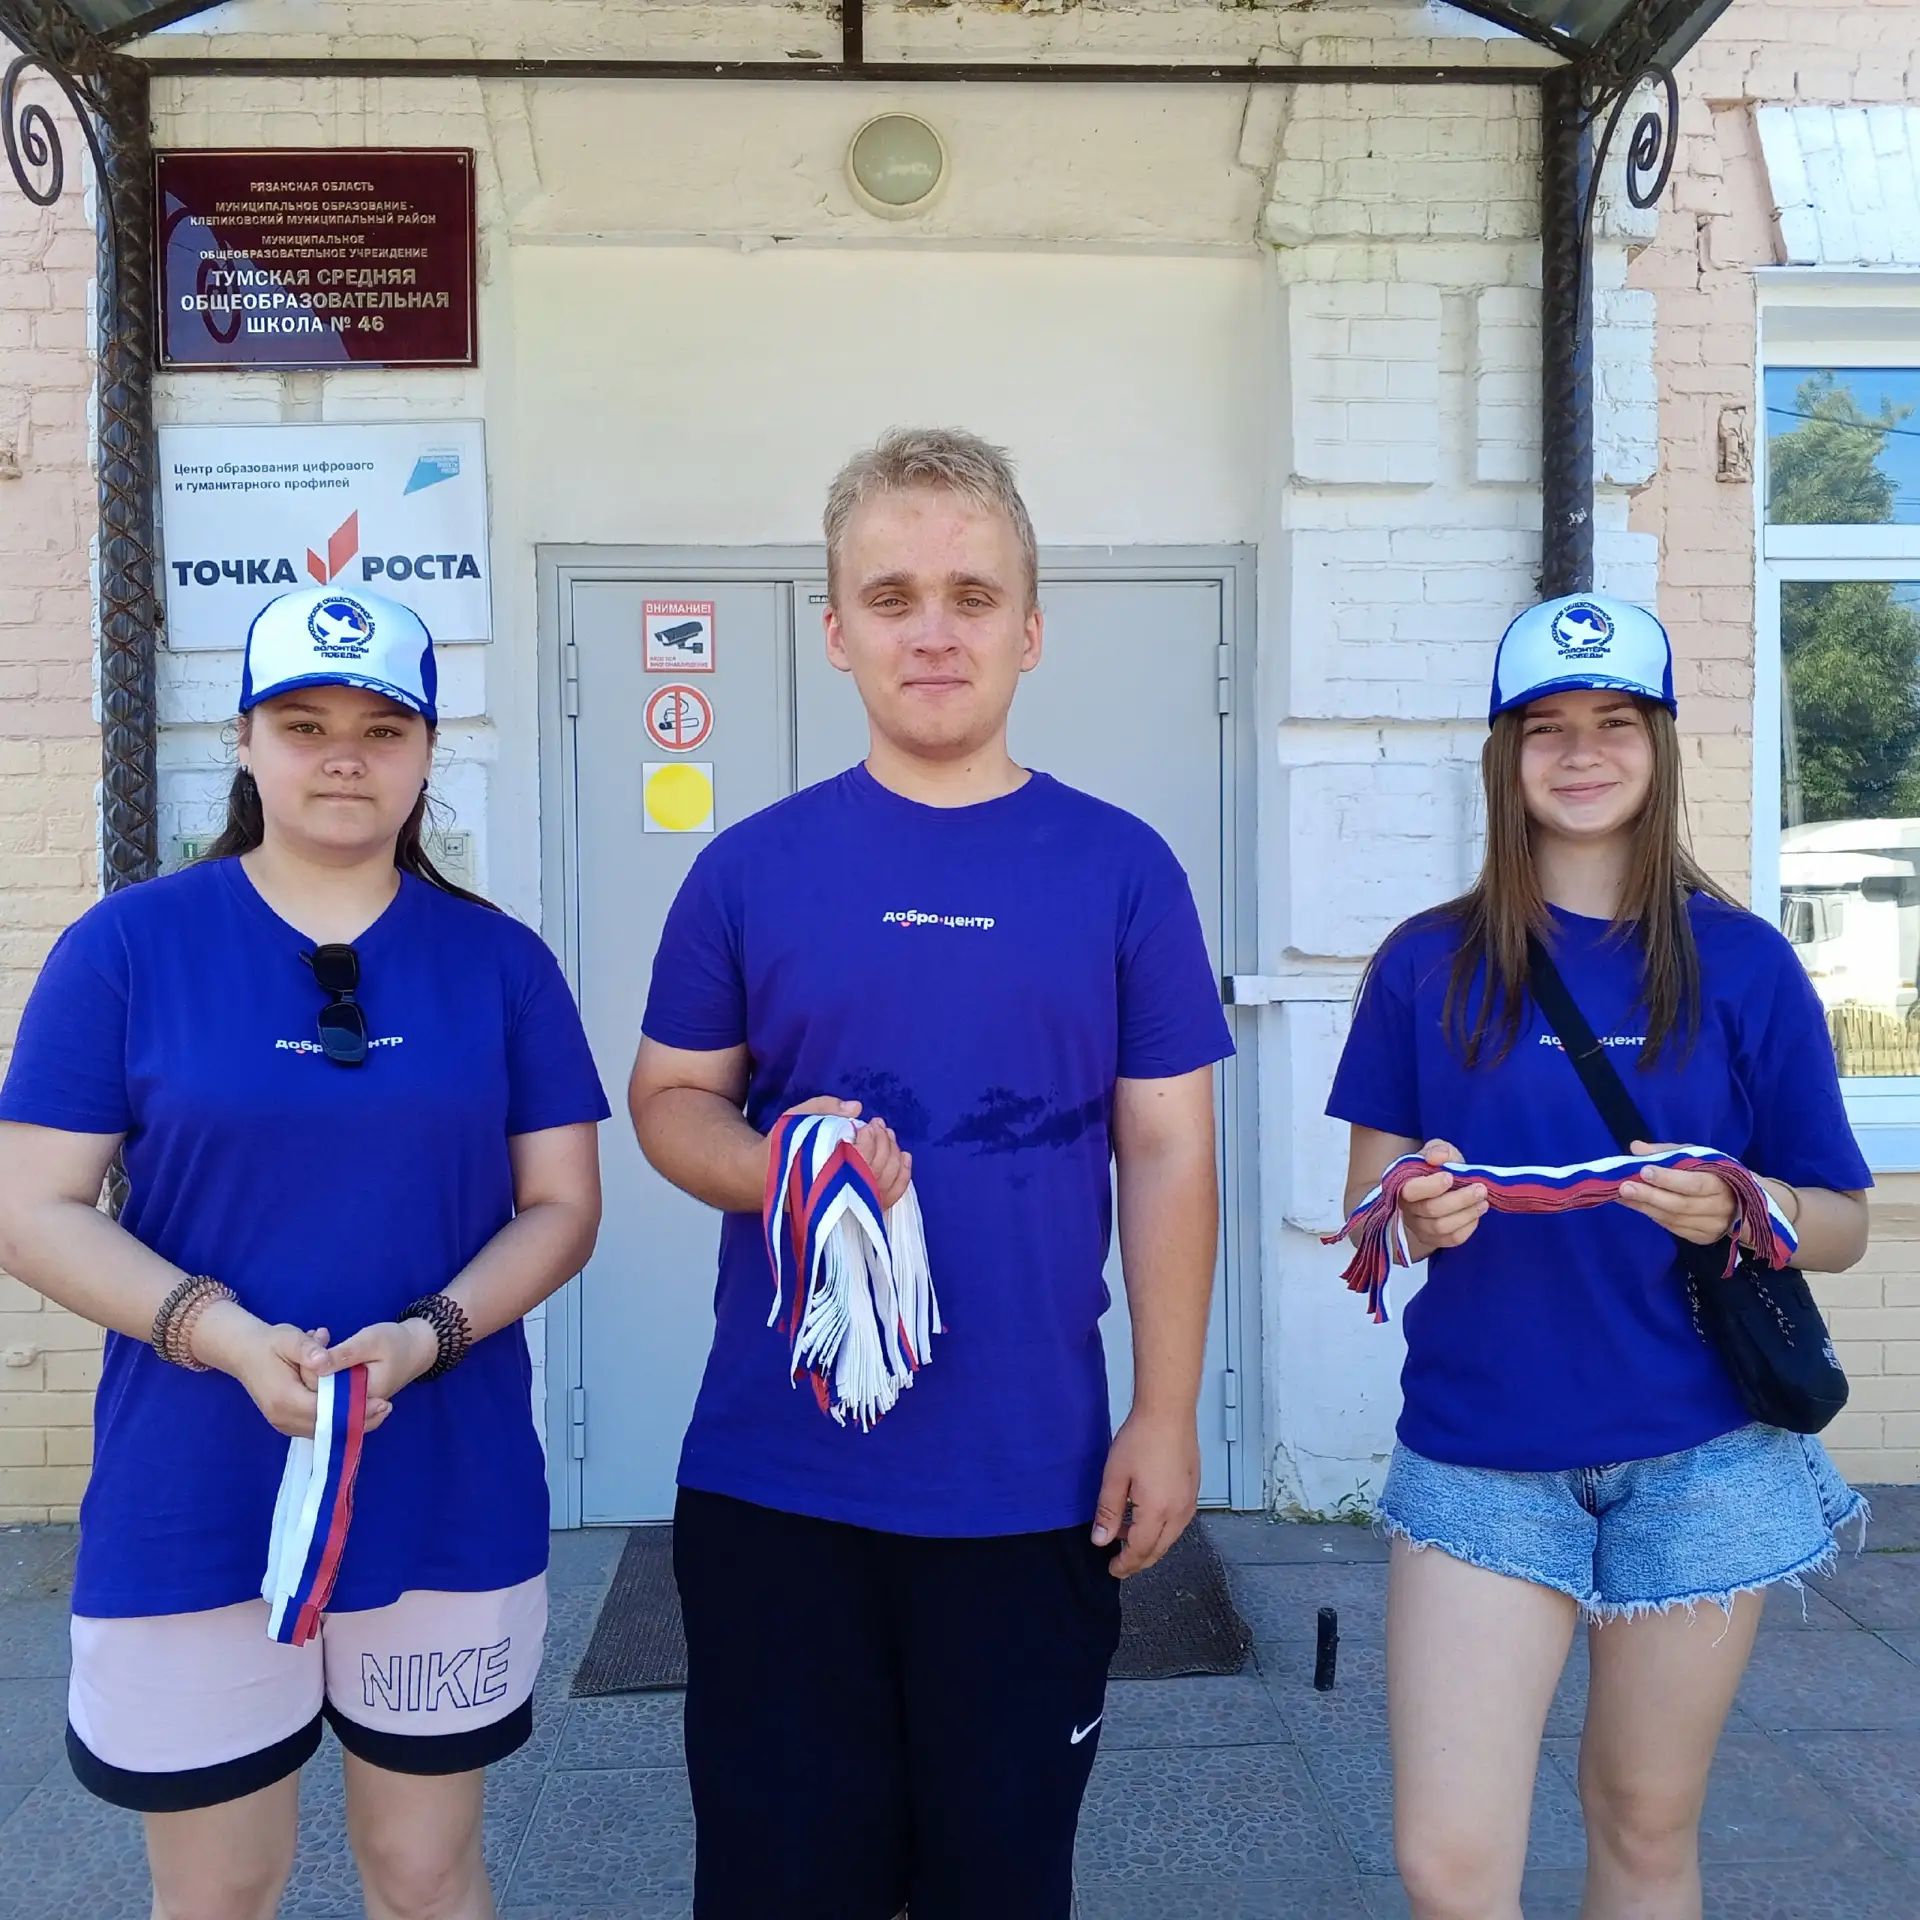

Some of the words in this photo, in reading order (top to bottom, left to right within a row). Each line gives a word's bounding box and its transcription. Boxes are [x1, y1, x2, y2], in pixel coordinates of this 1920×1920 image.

[250, 181, 319, 193] РЯЗАНСКАЯ
[322, 181, 375, 192] ОБЛАСТЬ
[215, 201, 319, 214] МУНИЦИПАЛЬНОЕ
[322, 200, 407, 212] ОБРАЗОВАНИЕ
[190, 213, 284, 226] КЛЕПИКОВСКИЙ
[287, 213, 395, 227] МУНИЦИПАЛЬНЫЙ
[398, 212, 436, 225] РАЙОН
[262, 234, 365, 246] МУНИЦИПАЛЬНОЕ
[200, 248, 346, 261] ОБЩЕОБРАЗОВАТЕЛЬНОЕ
[350, 248, 428, 259] УЧРЕЖДЕНИЕ
[212, 269, 310, 287] ТУМСКАЯ
[317, 268, 416, 288] СРЕДНЯЯ
[181, 291, 450, 313] ОБЩЕОБРАЗОВАТЕЛЬНАЯ
[247, 316, 324, 333] ШКОЛА
[330, 315, 351, 332] №
[358, 315, 385, 331] 46
[174, 463, 213, 478] Центр
[216, 461, 299, 475] образования
[302, 460, 374, 474] цифрового
[175, 482, 183, 491] и
[186, 480, 281, 493] гуманитарного
[284, 477, 350, 491] профилей
[172, 557, 298, 586] ТОЧКА
[362, 554, 481, 581] РОСТА
[646, 603, 711, 613] ВНИМАНИЕ!
[361, 1637, 510, 1711] NIKE
